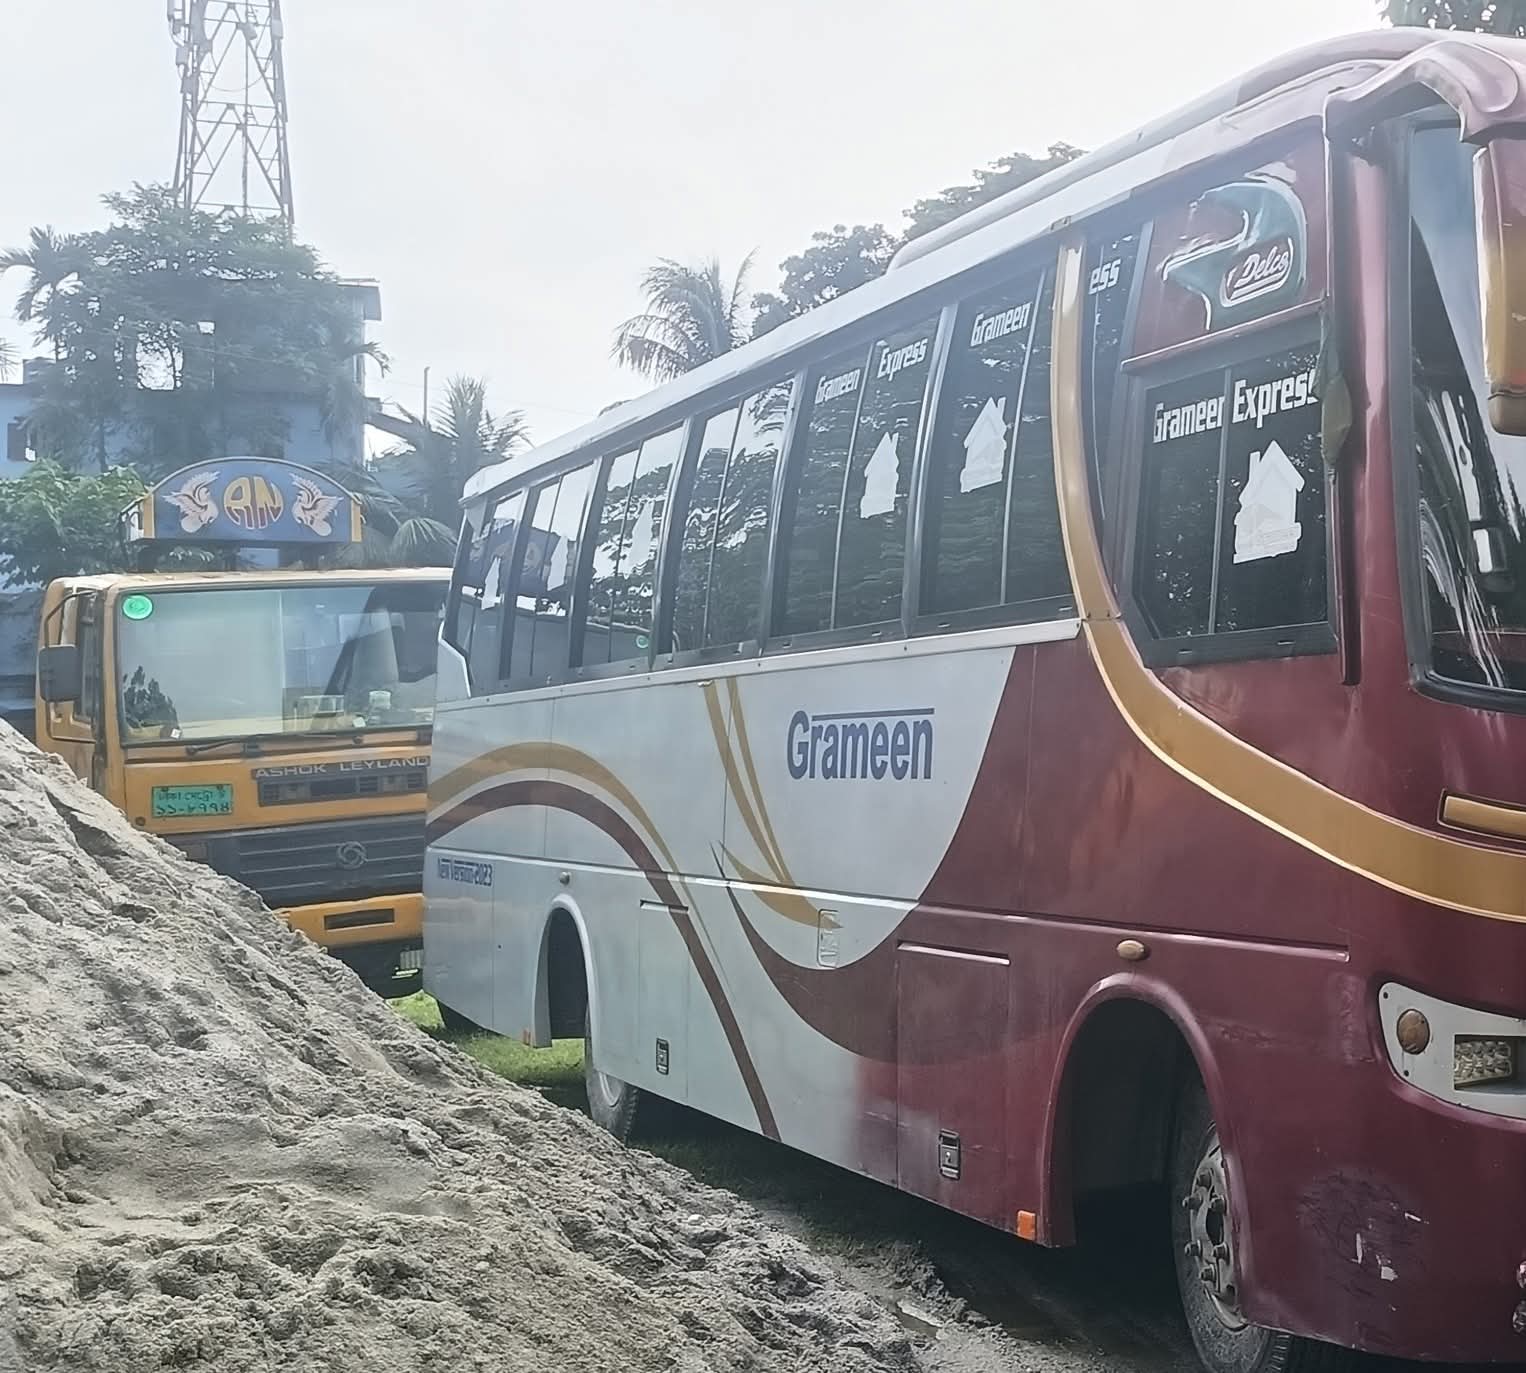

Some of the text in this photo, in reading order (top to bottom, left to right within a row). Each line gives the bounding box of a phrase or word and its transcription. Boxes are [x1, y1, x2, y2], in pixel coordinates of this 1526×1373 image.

[970, 301, 1033, 348] Grameen
[815, 338, 929, 405] Grameen Express
[256, 756, 429, 778] ASHOK LEYLAND
[787, 708, 935, 781] Grameen
